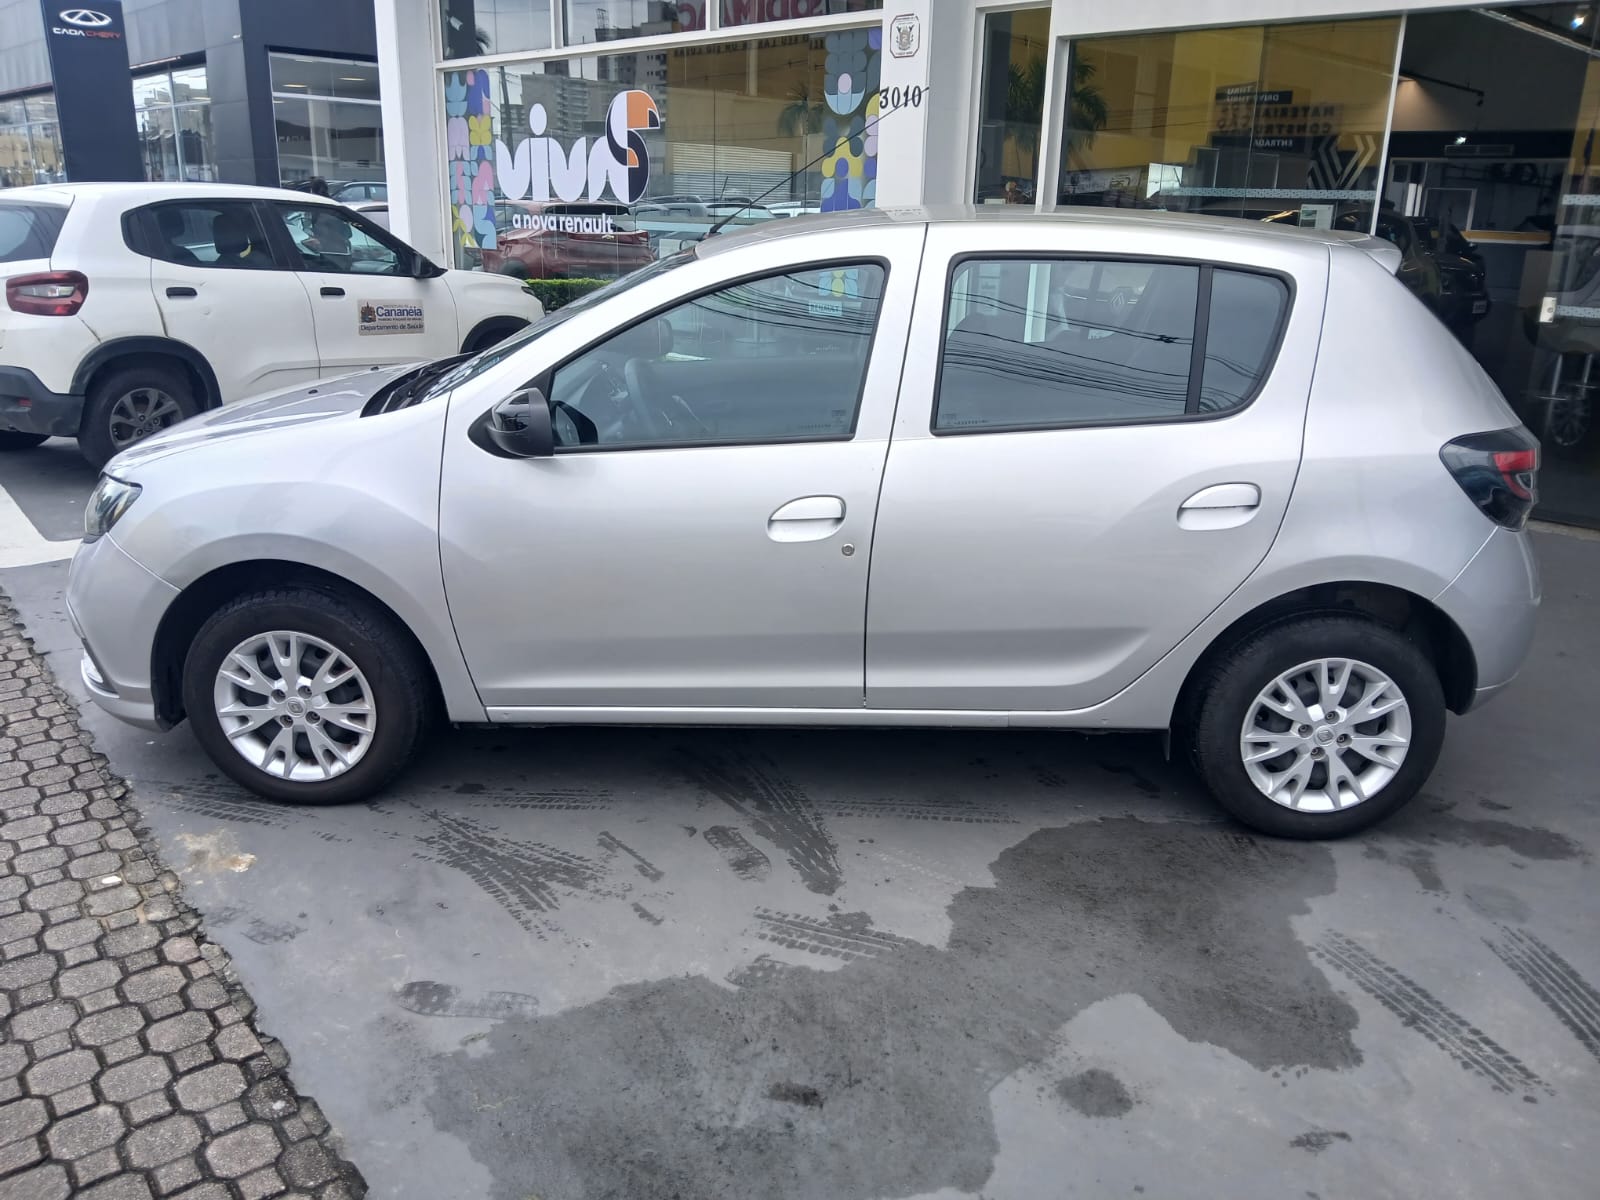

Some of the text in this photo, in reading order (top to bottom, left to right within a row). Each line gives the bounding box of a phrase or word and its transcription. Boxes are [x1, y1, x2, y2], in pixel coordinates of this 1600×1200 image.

[879, 85, 921, 109] 3010
[512, 213, 614, 234] a nova renault
[376, 306, 423, 317] Cananéia
